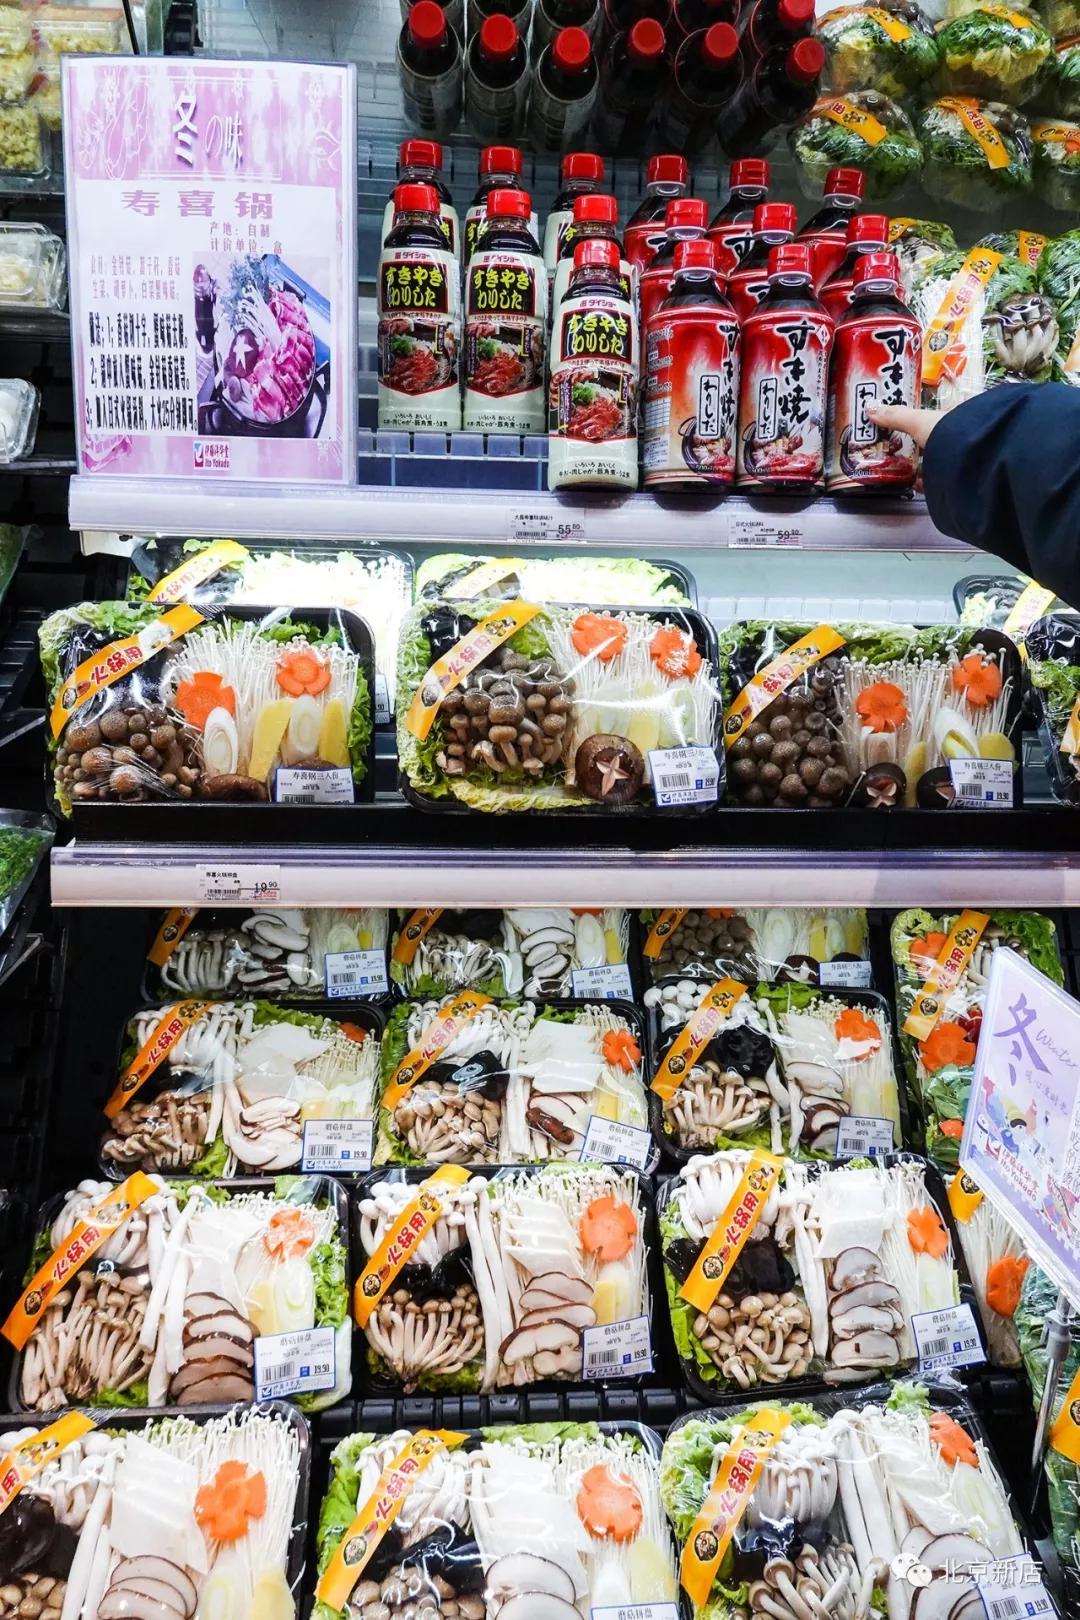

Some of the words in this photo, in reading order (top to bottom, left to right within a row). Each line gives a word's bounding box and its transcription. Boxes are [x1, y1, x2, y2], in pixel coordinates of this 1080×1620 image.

[121, 189, 274, 220] 寿喜锅
[385, 266, 443, 287] すきやき
[473, 269, 529, 290] すきやき
[389, 287, 437, 308] わりした
[478, 289, 522, 310] わりした
[568, 314, 628, 336] すきやき
[573, 333, 622, 355] わりした
[776, 320, 816, 425] すき焼
[702, 378, 718, 433] わりした
[760, 382, 775, 435] わりした
[90, 645, 143, 685] 火锅用
[449, 635, 491, 676] 火锅用
[292, 771, 339, 781] 寿喜锅三人份
[148, 1019, 184, 1064] 火锅用
[422, 1018, 458, 1059] 火锅用
[992, 992, 1053, 1087] 冬
[1010, 1168, 1037, 1202] Yokado
[387, 1211, 428, 1266] 火锅用
[727, 1191, 760, 1246] 火锅用
[53, 1226, 101, 1282] 火锅用
[377, 1457, 420, 1522] 火锅用
[721, 1448, 758, 1519] 火锅用
